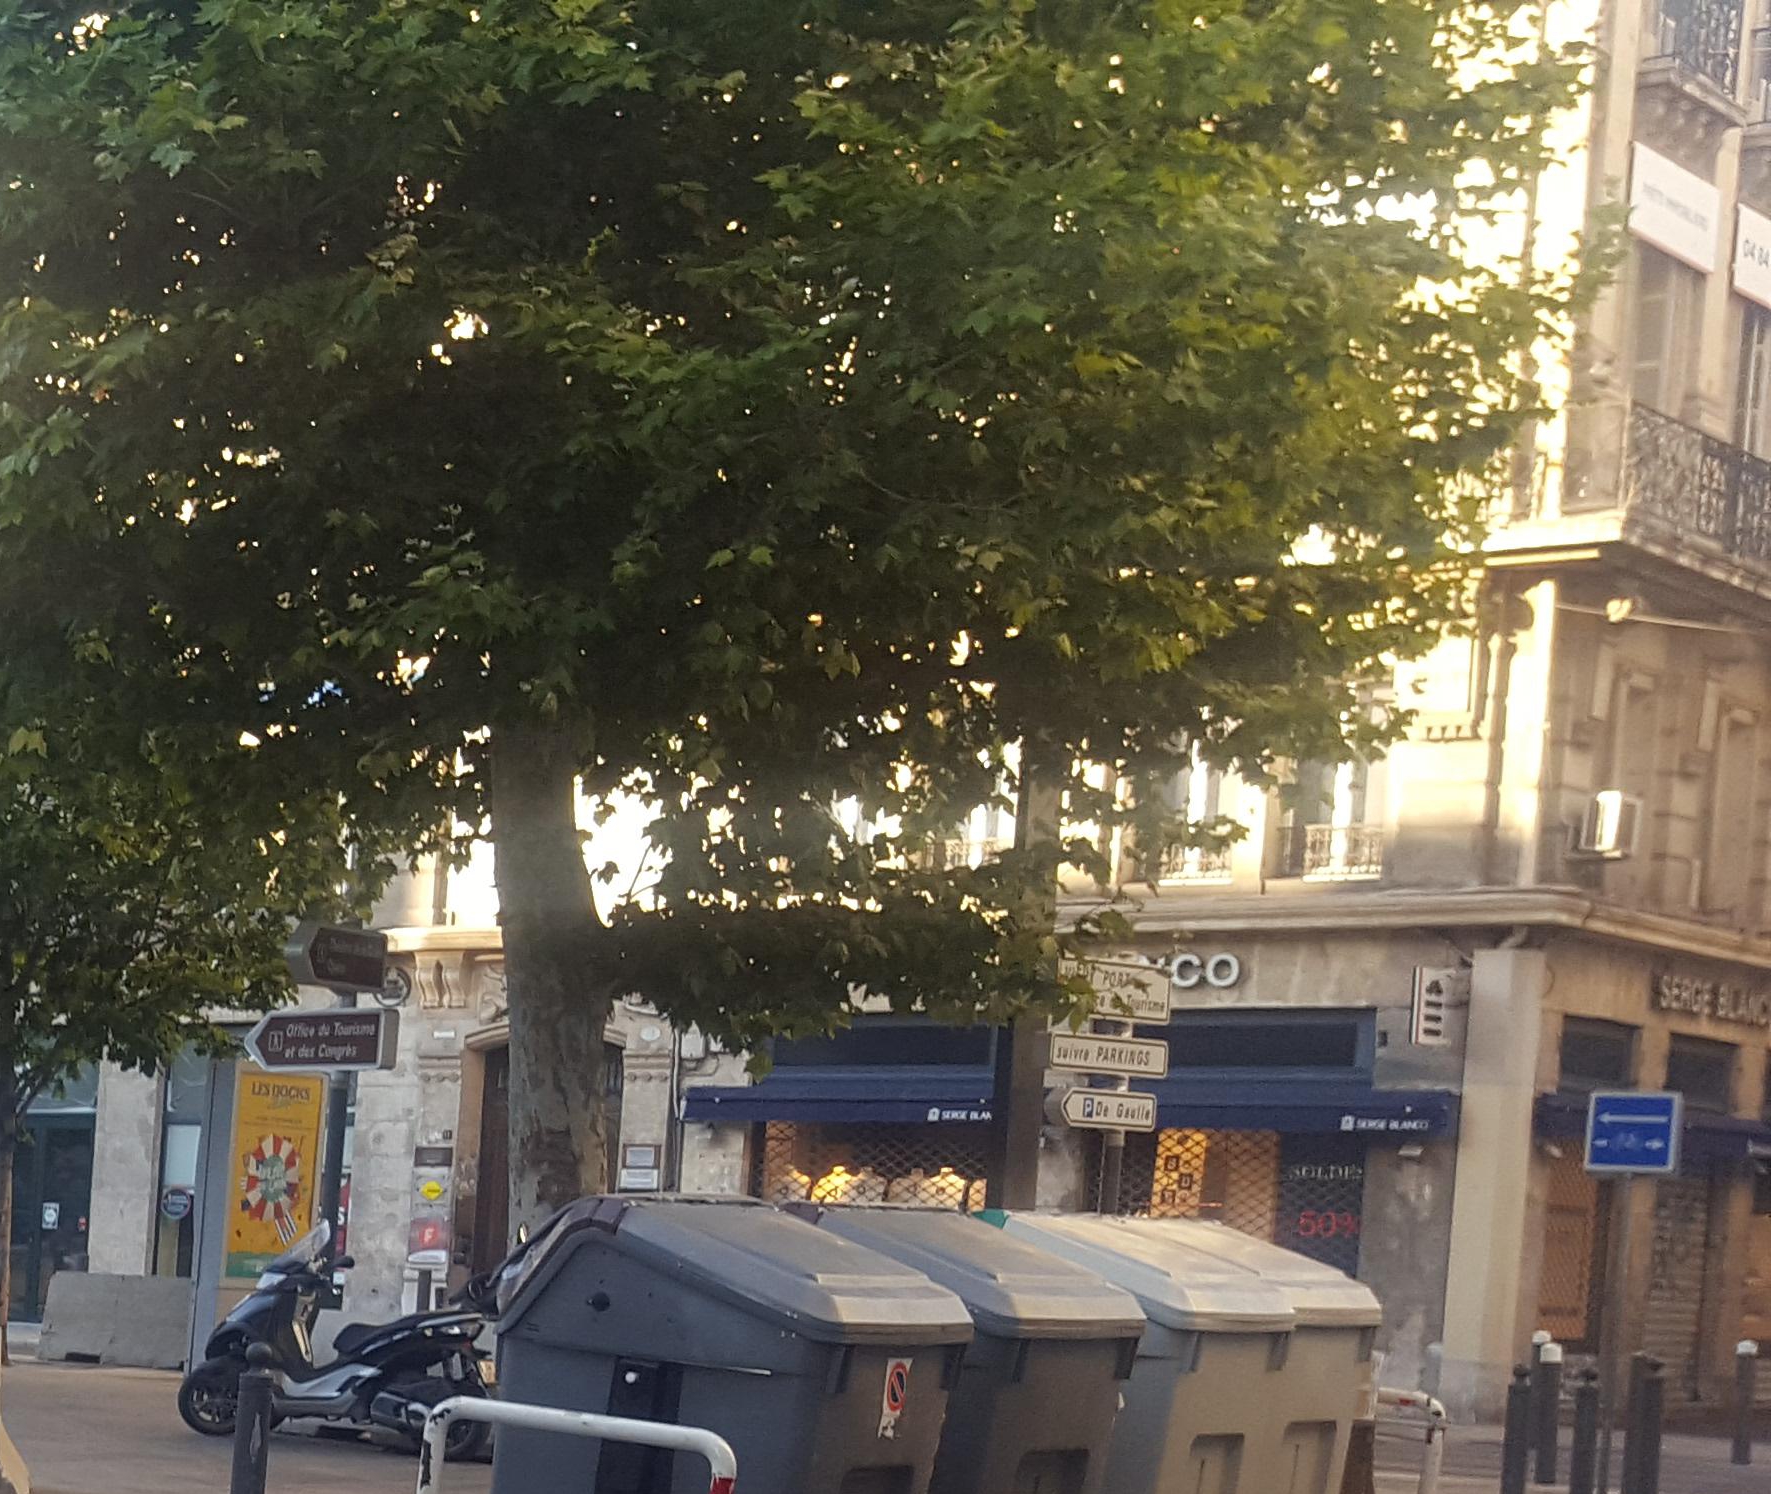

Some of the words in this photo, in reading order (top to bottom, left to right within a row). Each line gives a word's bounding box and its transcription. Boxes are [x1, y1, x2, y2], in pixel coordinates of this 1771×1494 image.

[287, 1023, 314, 1037] Office
[318, 1022, 330, 1036] du
[334, 1021, 375, 1036] Tourisme
[284, 1046, 295, 1058] et
[298, 1044, 316, 1058] des
[1056, 1045, 1089, 1061] suivre
[1096, 1046, 1150, 1066] PARKINGS
[1096, 1102, 1108, 1117] De
[1116, 1104, 1150, 1121] Gaulle
